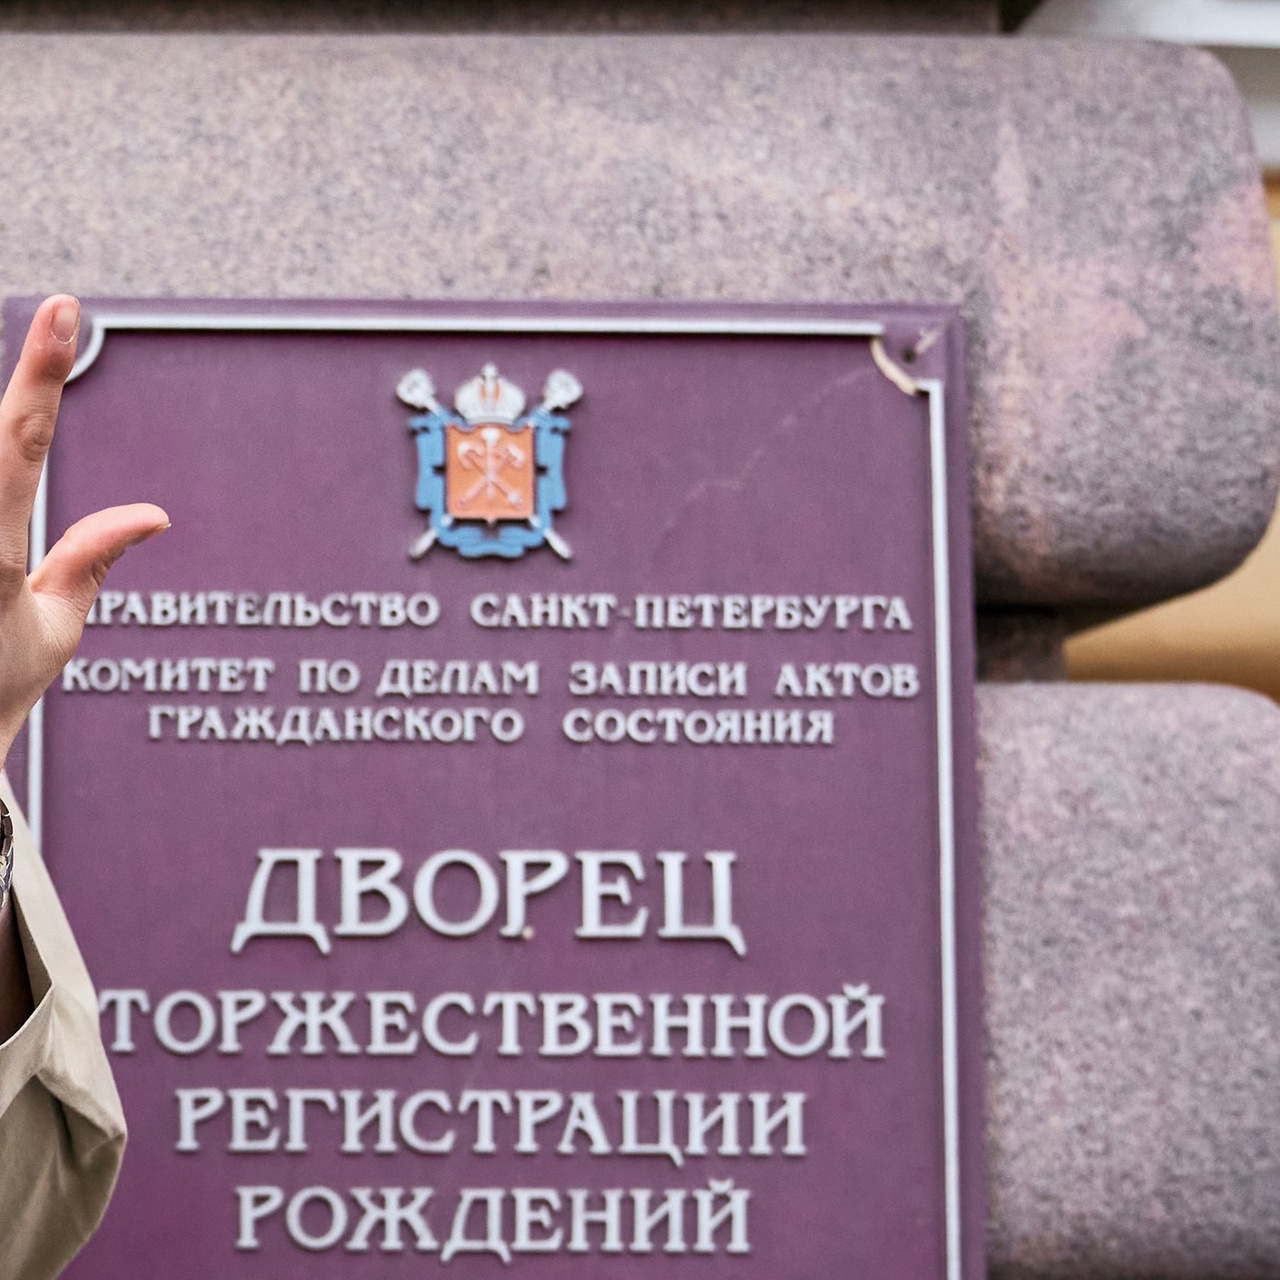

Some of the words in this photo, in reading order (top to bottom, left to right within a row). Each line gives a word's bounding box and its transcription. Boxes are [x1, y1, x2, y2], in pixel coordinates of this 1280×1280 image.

[62, 656, 276, 693] КОМИТЕТ
[298, 658, 361, 693] ПО
[375, 658, 540, 697] ДЕЛАМ
[568, 660, 748, 697] ЗАПИСИ
[774, 661, 920, 698] АКТОВ
[148, 704, 525, 745] ГРАЖДАНСКОГО
[561, 708, 835, 744] СОСТОЯНИЯ
[230, 847, 747, 956] ДВОРЕЦ
[99, 982, 886, 1058] ТОРЖЕСТВЕННОЙ
[175, 1087, 807, 1167] РЕГИСТРАЦИИ
[236, 1177, 751, 1263] РОЖДЕНИЙ
